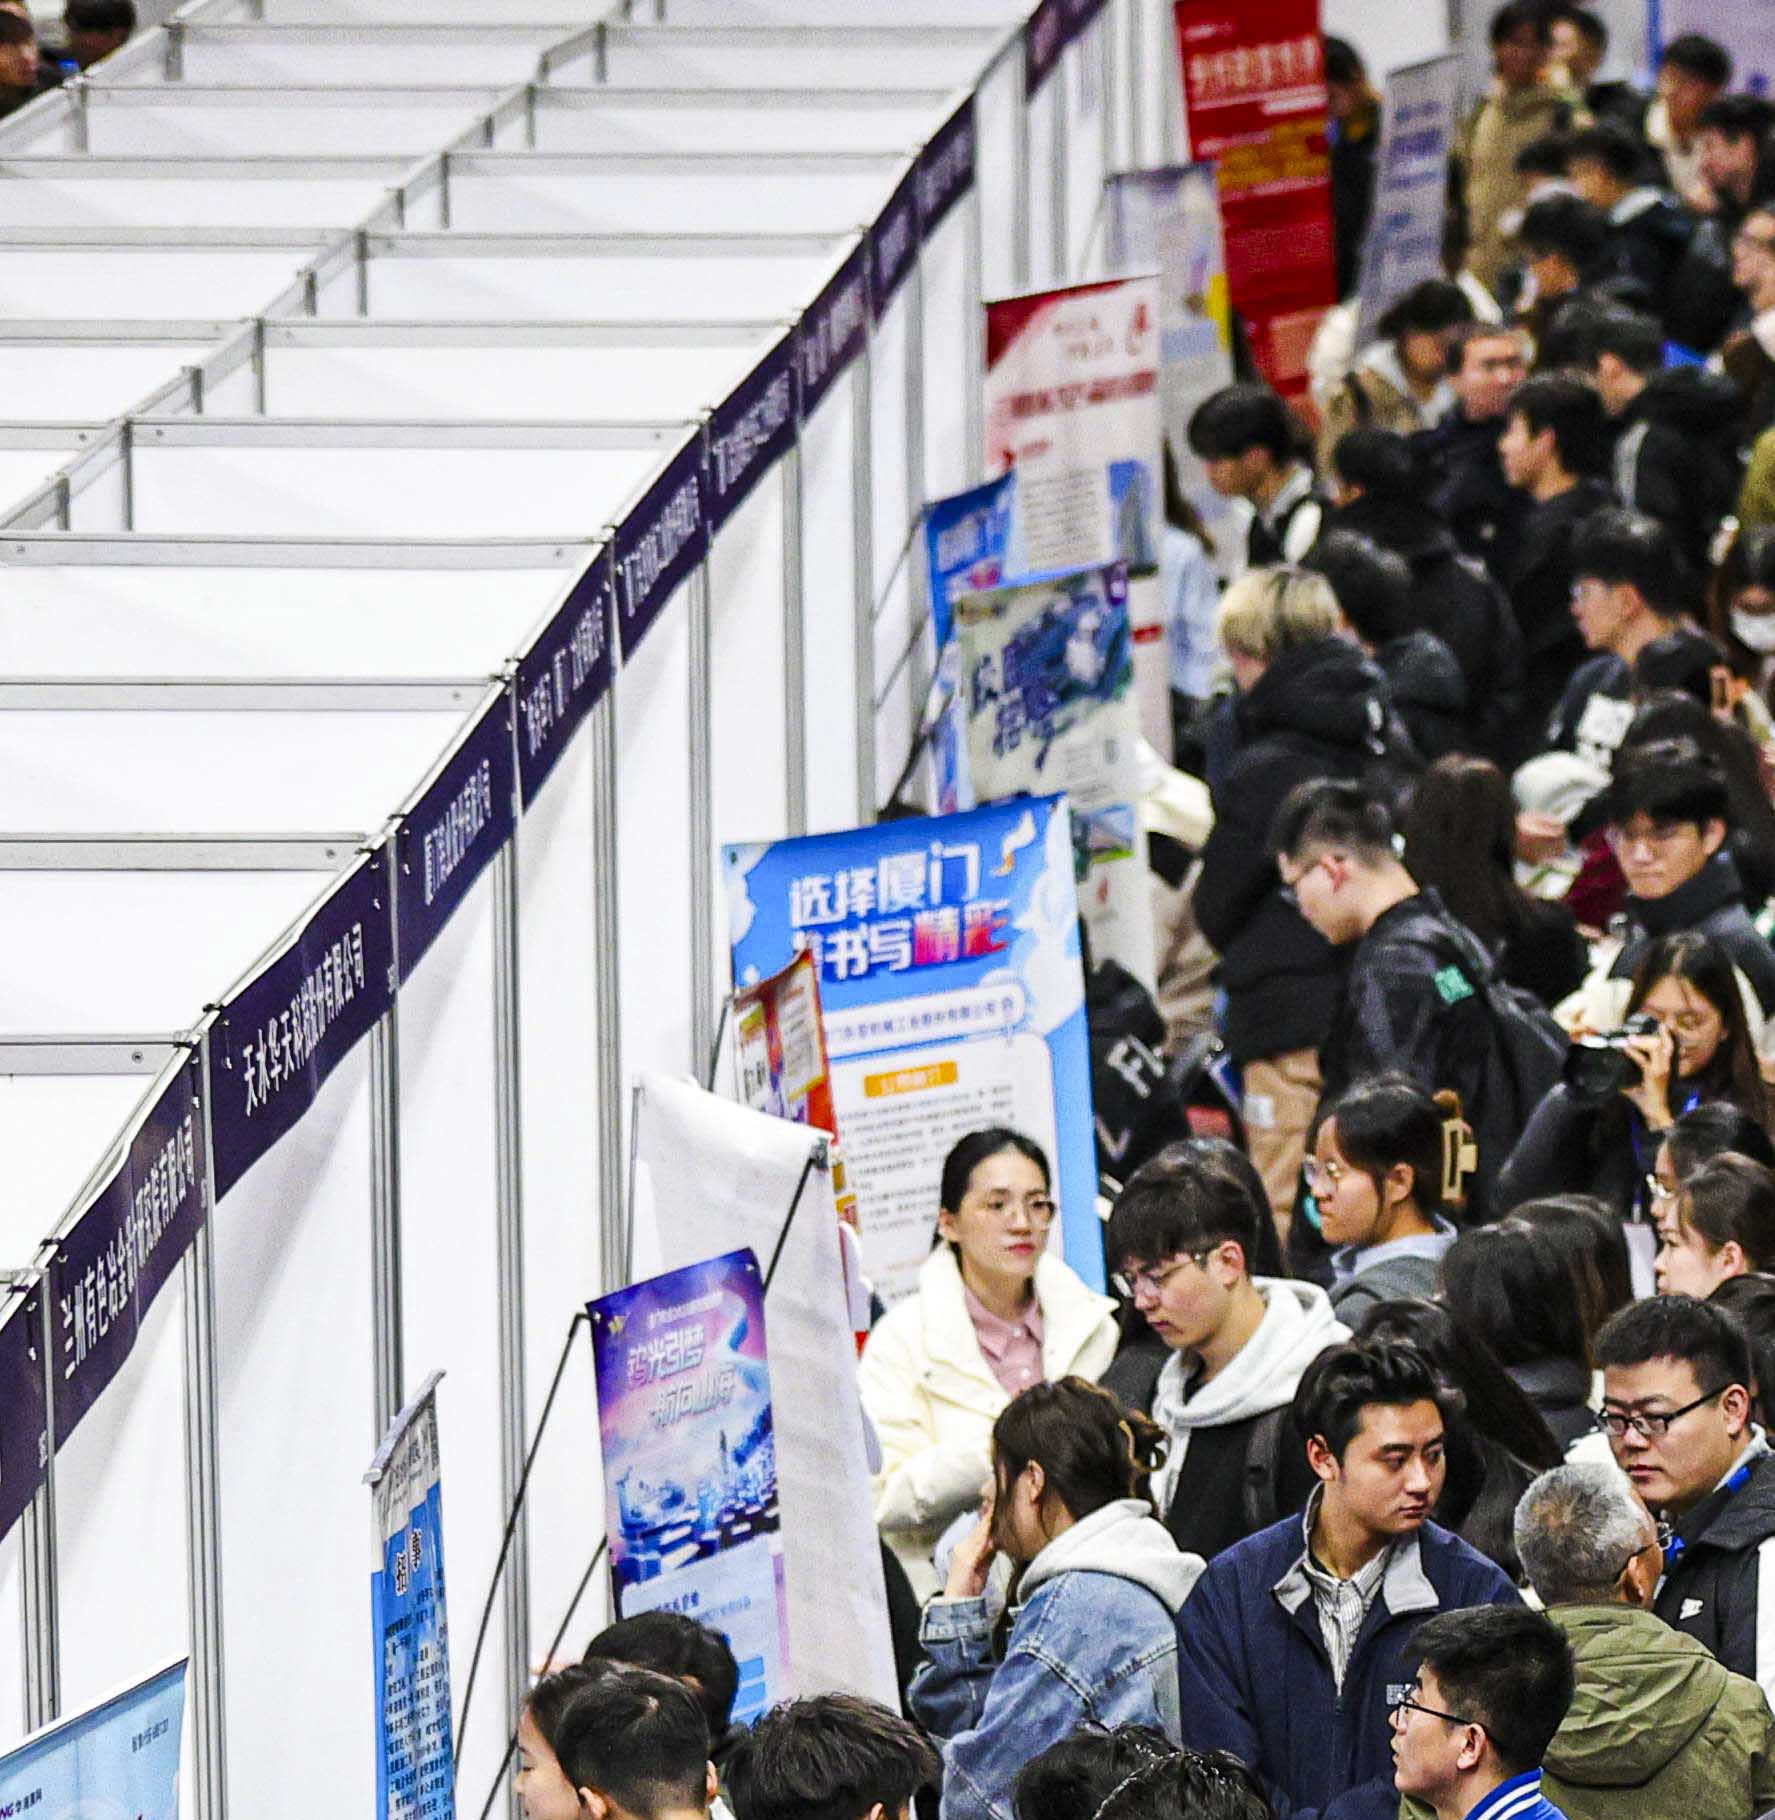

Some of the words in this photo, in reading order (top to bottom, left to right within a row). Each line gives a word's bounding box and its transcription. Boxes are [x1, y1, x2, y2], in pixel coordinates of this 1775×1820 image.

[788, 840, 981, 926] 选择厦门
[243, 923, 364, 1117] 天水华天科技股份有限公司
